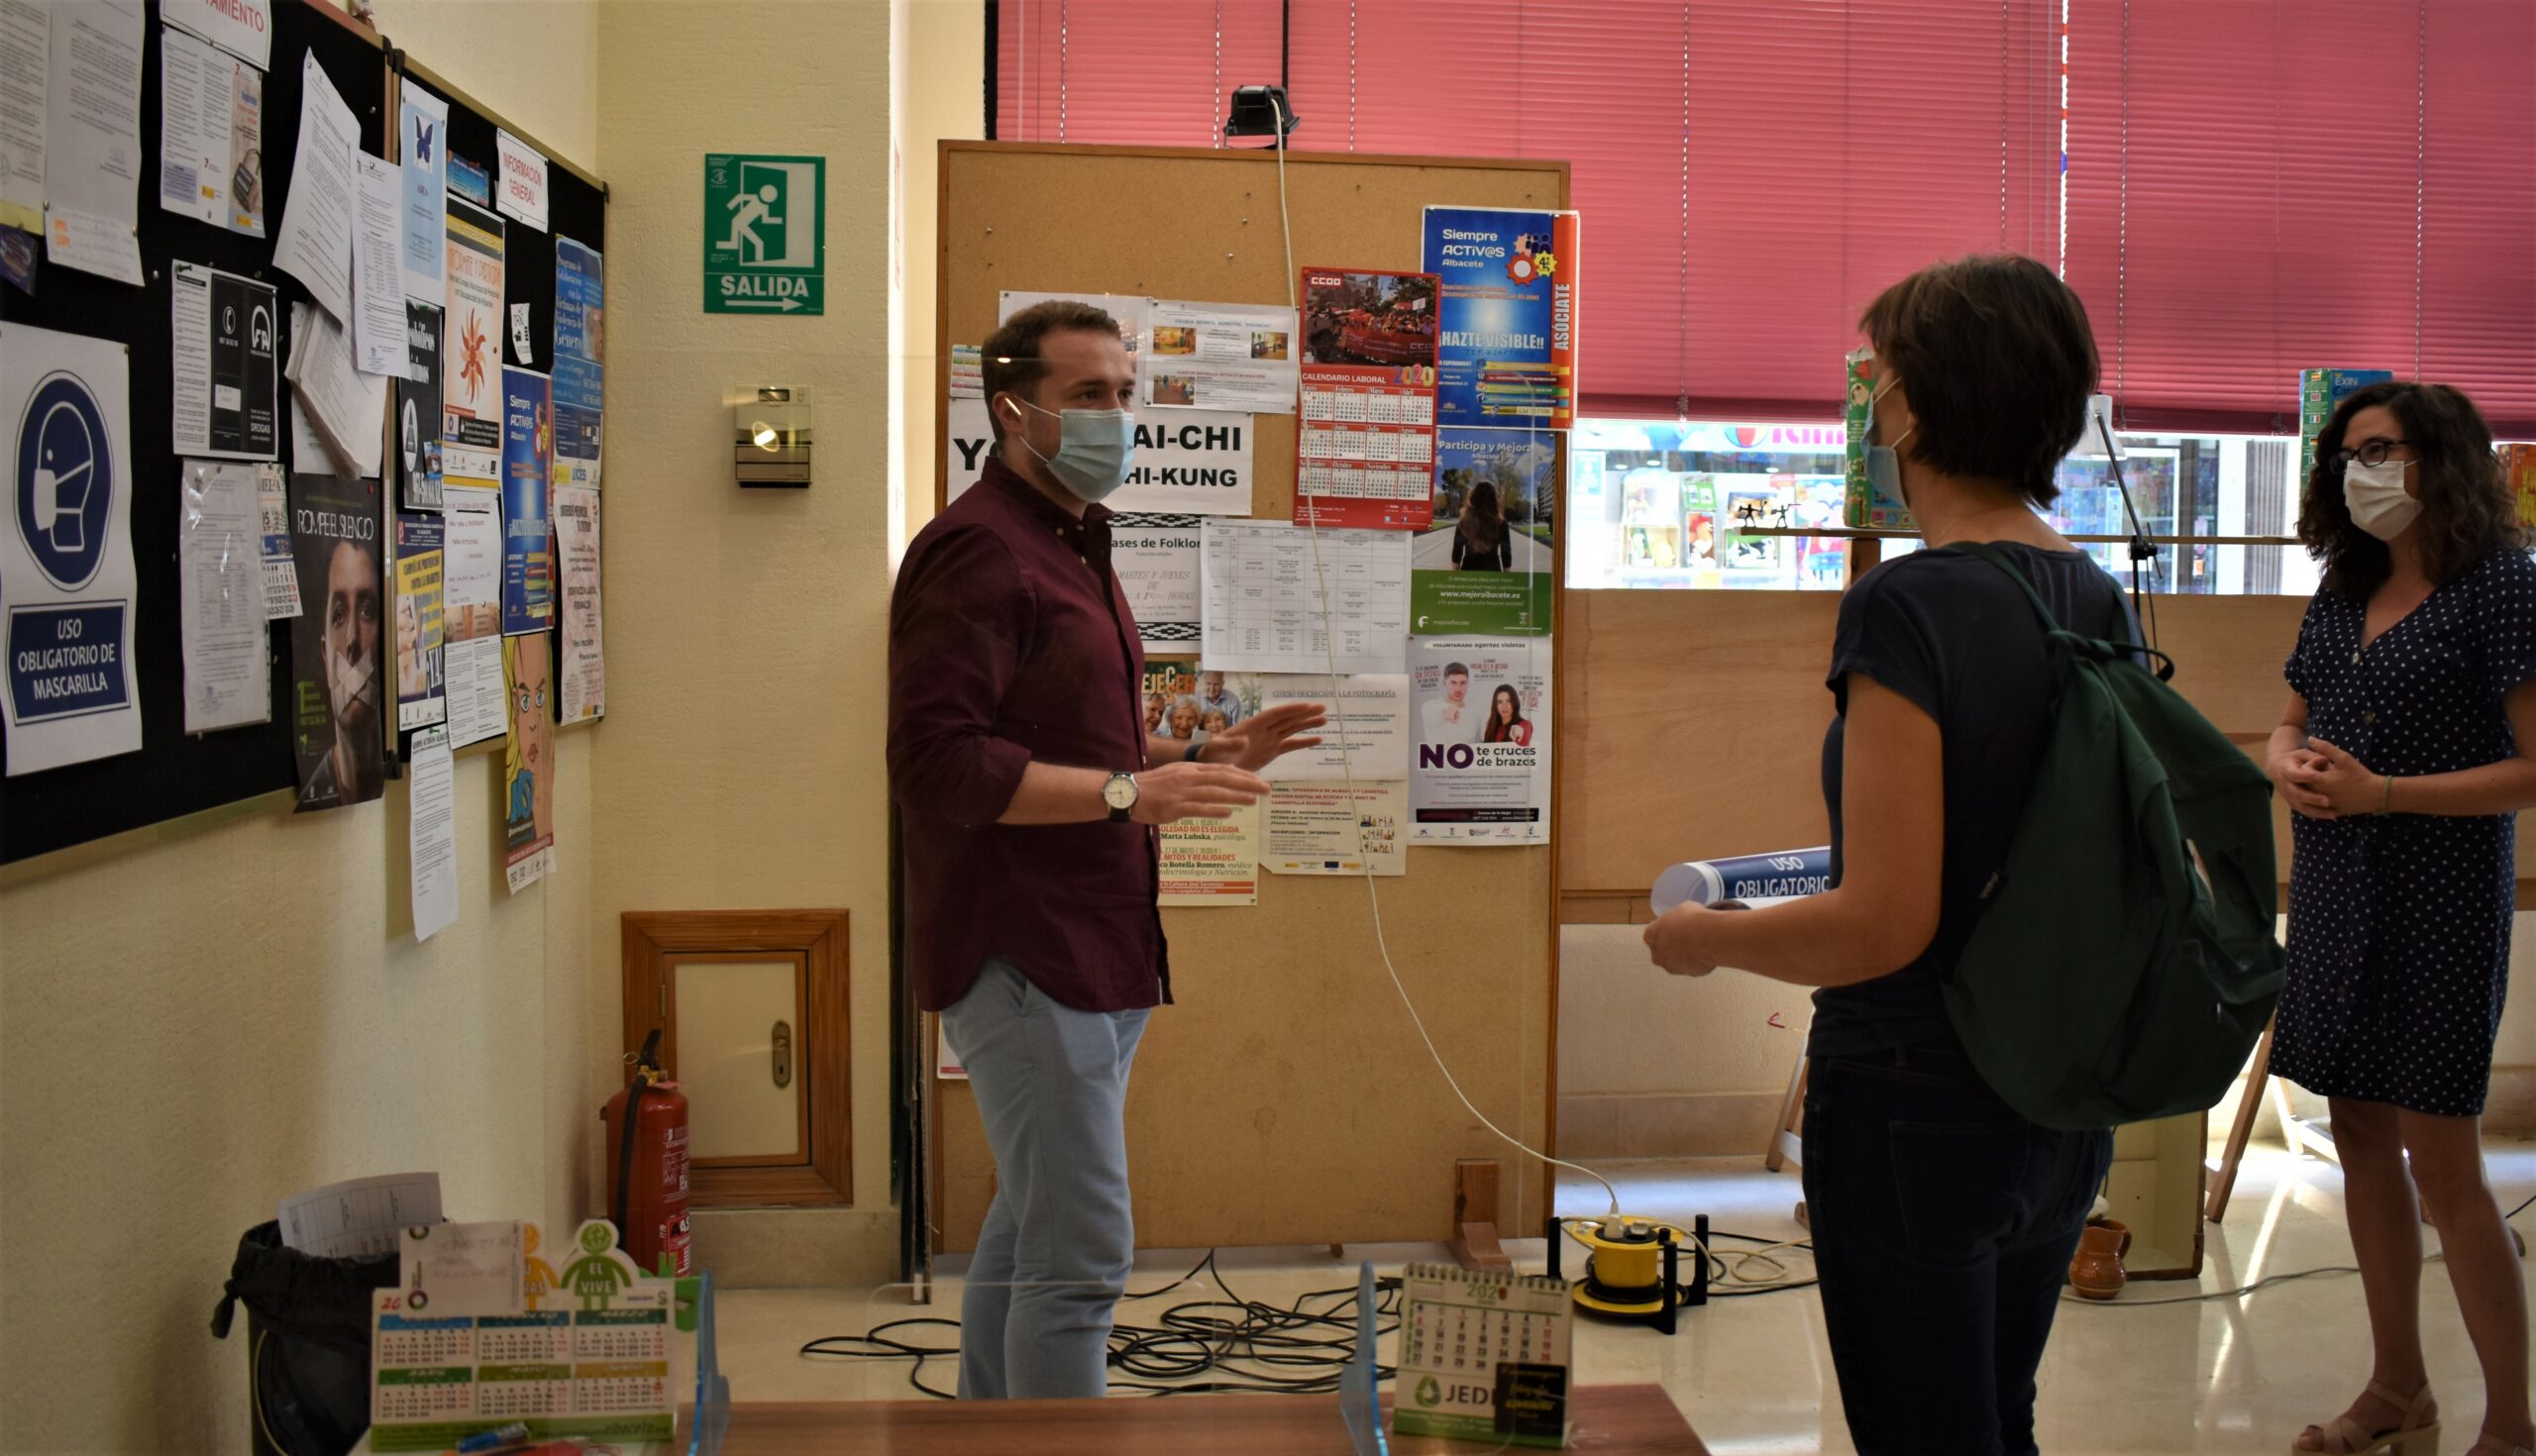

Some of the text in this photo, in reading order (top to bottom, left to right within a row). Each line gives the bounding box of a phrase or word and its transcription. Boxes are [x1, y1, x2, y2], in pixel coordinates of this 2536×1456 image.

[206, 0, 264, 33] AMIENTO
[502, 151, 543, 187] INFORMACIÓN
[509, 178, 536, 206] GENERAL
[1442, 229, 1498, 243] Siempre
[1442, 259, 1484, 268] Albacete
[720, 274, 809, 298] SALIDA
[1311, 276, 1341, 286] CCOO
[1552, 283, 1569, 351] ASÓCIATE
[554, 325, 582, 351] Género
[1486, 333, 1544, 349] VISIBLE!!
[1303, 372, 1386, 384] CALENDARIO LABORAL
[1392, 364, 1434, 387] 2020
[2335, 376, 2358, 386] EXIN
[509, 394, 531, 411] Siempre
[1133, 424, 1241, 451] AI-CHI
[1438, 441, 1486, 452] Participa
[1489, 444, 1496, 453] y
[1125, 467, 1238, 487] HI-KUNG
[297, 508, 330, 537] ROMPE
[330, 513, 340, 538] EL
[340, 513, 374, 541] SILENCIO
[1140, 538, 1156, 548] de
[1160, 538, 1202, 549] Folklor
[1118, 571, 1150, 579] MARTES
[1439, 590, 1521, 600] www.mejoralbacete.es
[57, 617, 82, 640] USO
[18, 643, 116, 673] OBLIGATORIO DE
[33, 672, 109, 700] MASCARILLA
[1352, 688, 1396, 697] FOTOGRAFÍA
[1420, 743, 1536, 770] NO te cruces
[1476, 757, 1536, 767] de brazos
[1767, 856, 1805, 872] USO
[589, 1262, 602, 1276] EL
[581, 1280, 612, 1294] VIVE
